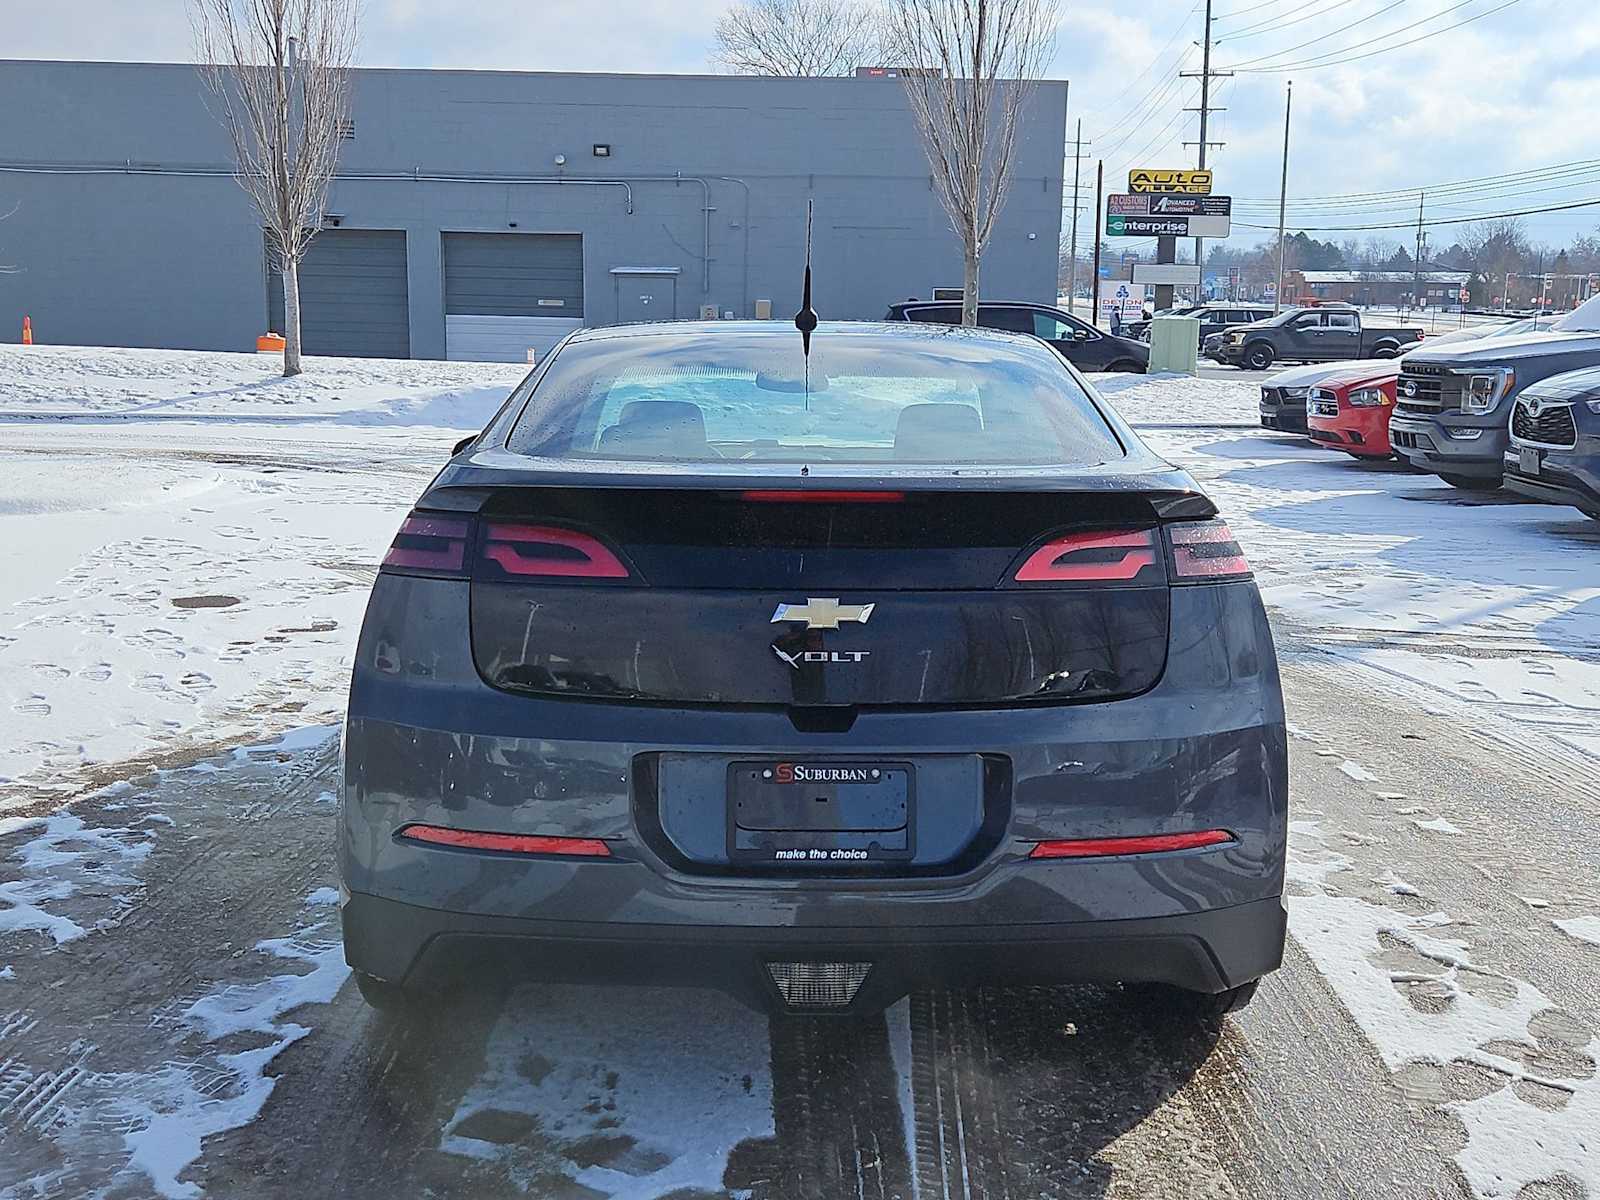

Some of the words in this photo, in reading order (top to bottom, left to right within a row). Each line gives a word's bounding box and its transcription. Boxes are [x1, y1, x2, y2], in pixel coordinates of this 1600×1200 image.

[1131, 185, 1210, 193] VILLAGE
[1111, 221, 1187, 232] enterprise
[771, 644, 870, 669] VOLT
[794, 765, 867, 780] SUBURBAN
[775, 849, 806, 859] make
[809, 849, 827, 859] the
[830, 849, 868, 859] choice
